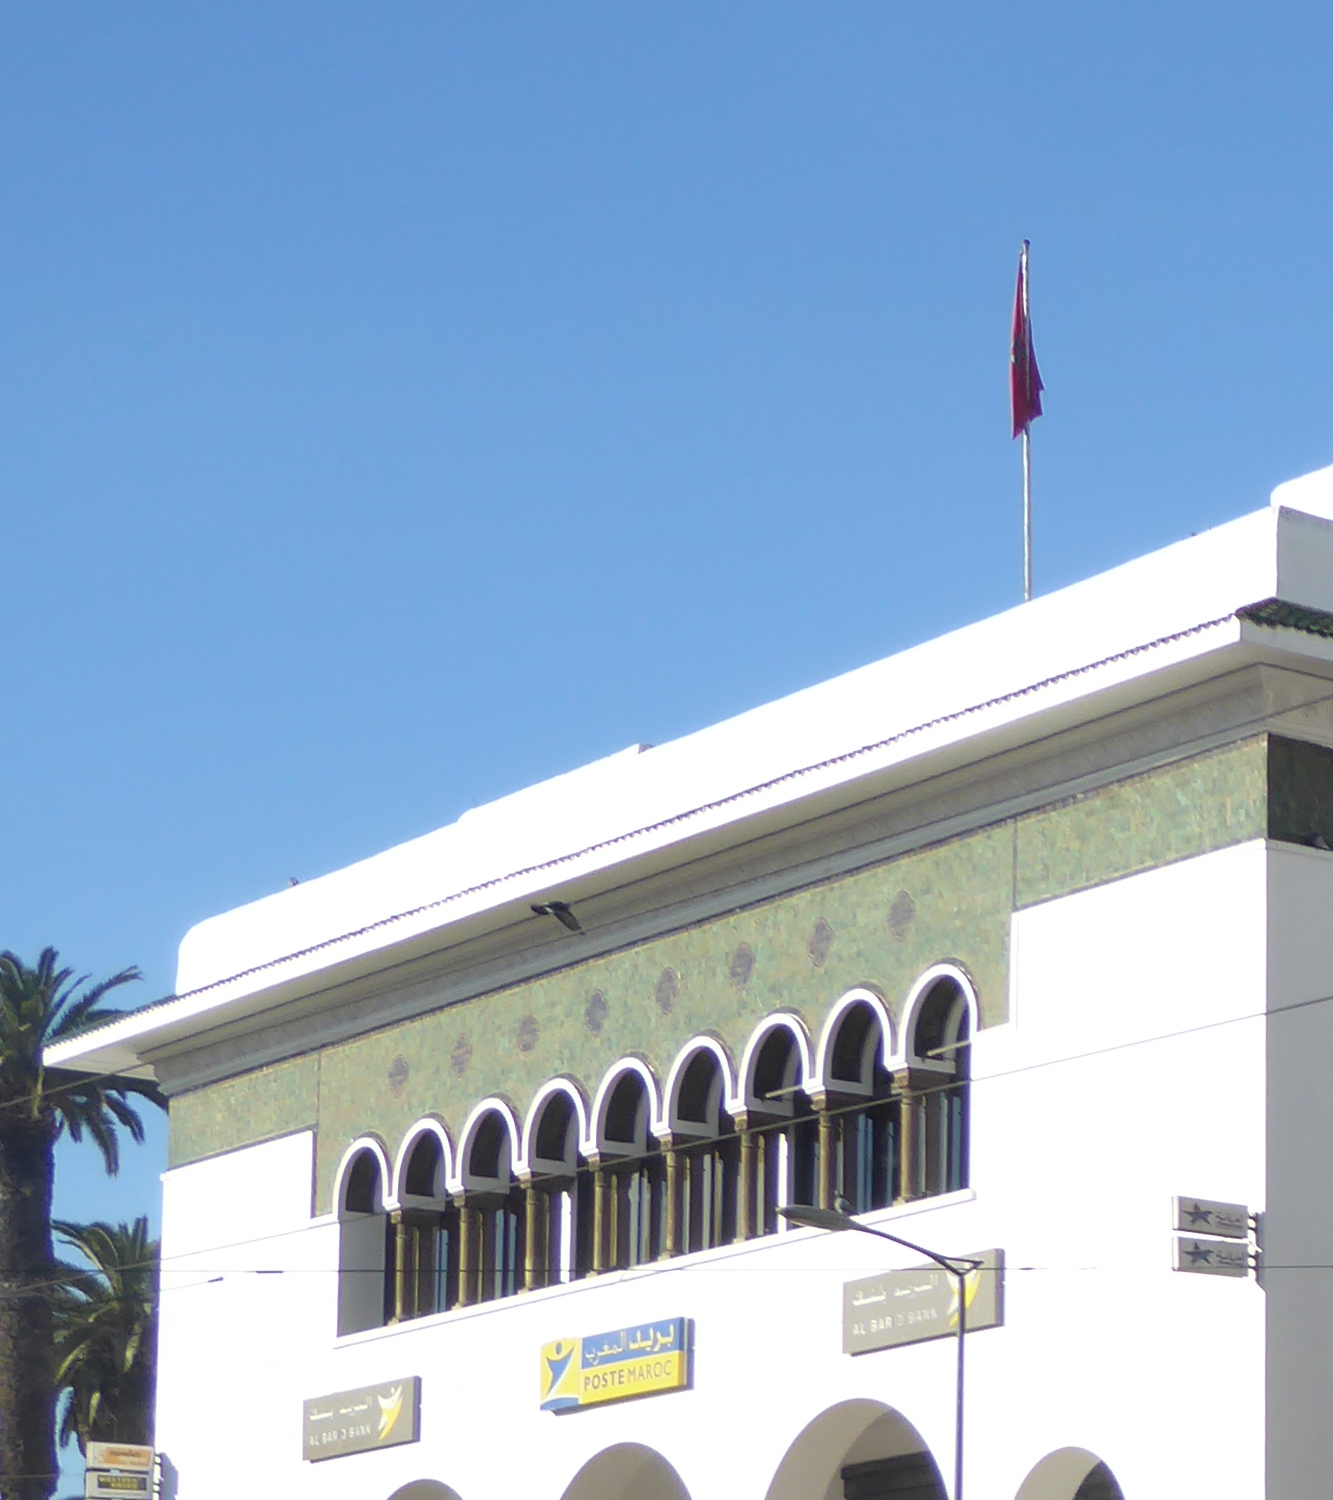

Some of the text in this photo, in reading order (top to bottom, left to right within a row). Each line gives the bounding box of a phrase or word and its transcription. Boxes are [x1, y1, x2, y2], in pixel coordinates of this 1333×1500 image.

[851, 1307, 938, 1336] AL BARD BANK
[585, 1323, 676, 1366] بريد المغرب
[583, 1359, 673, 1392] POSTE MAROC
[322, 1429, 347, 1446] BARD
